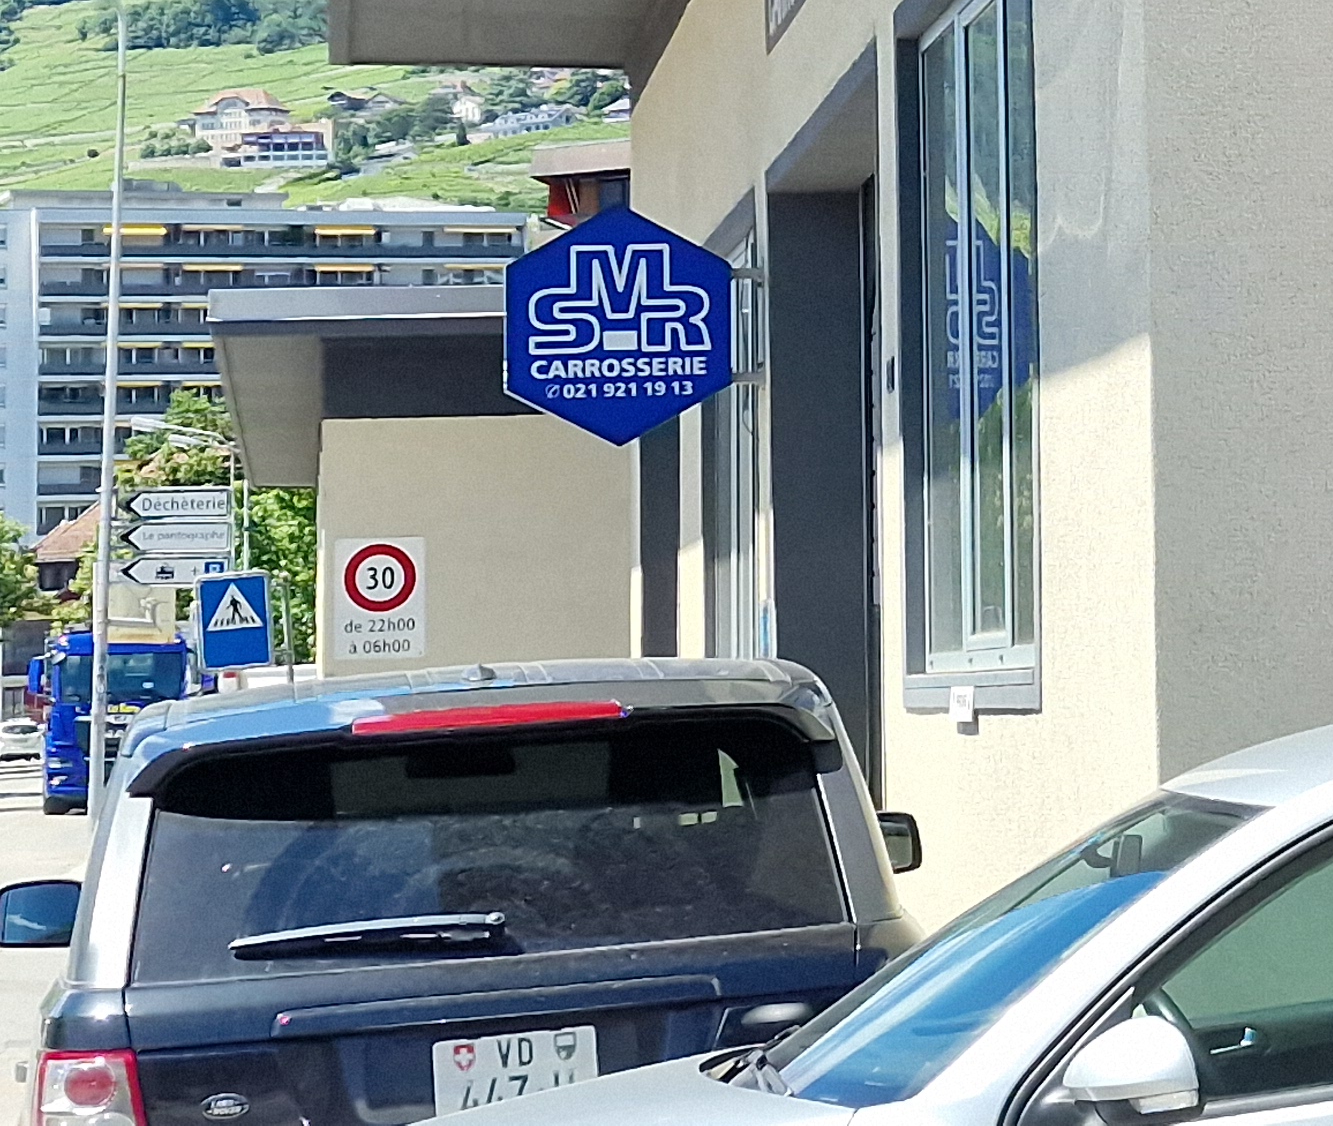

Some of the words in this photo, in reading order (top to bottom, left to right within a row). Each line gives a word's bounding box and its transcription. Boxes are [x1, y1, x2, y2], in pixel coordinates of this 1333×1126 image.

[530, 356, 708, 380] CARROSSERIE
[562, 383, 597, 399] 021
[603, 382, 637, 398] 921
[643, 381, 667, 397] 19
[671, 380, 693, 395] 13
[366, 566, 395, 590] 30
[344, 620, 362, 633] de
[368, 617, 416, 633] 22h00
[363, 638, 411, 653] 06h00
[497, 1037, 533, 1068] VD
